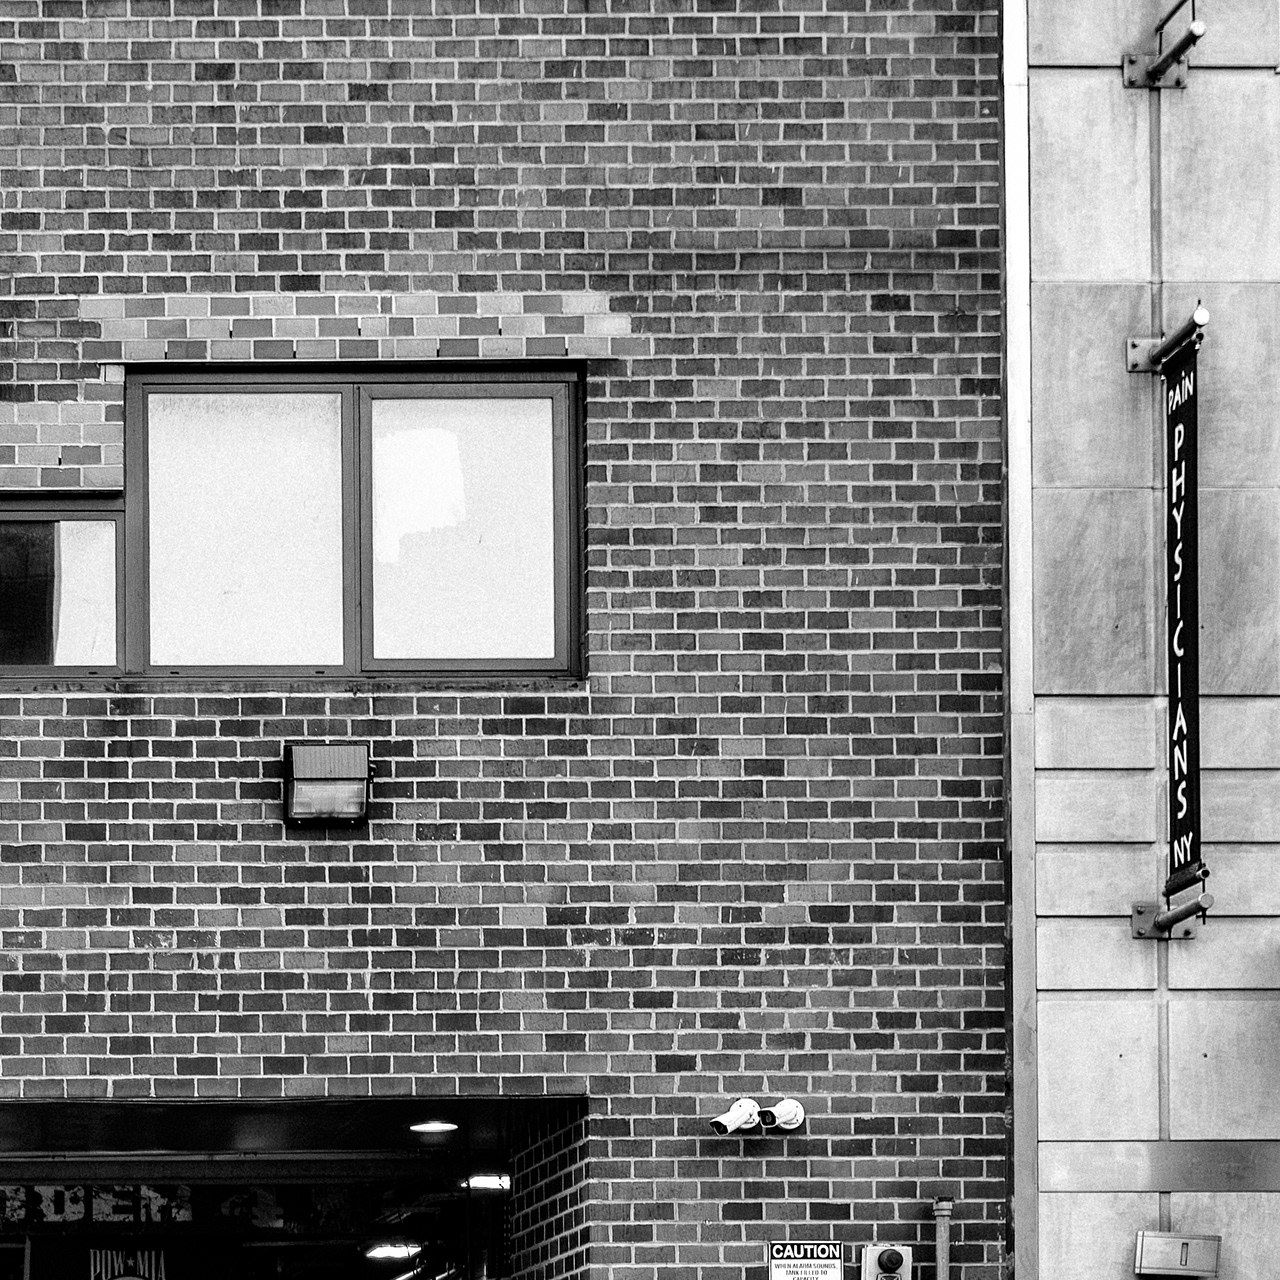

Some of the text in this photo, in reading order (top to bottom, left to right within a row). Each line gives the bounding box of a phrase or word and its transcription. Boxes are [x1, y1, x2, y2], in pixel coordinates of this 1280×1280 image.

[1173, 422, 1187, 820] PHYSICIANS
[1174, 831, 1193, 868] NY
[772, 1244, 840, 1258] CAUTION
